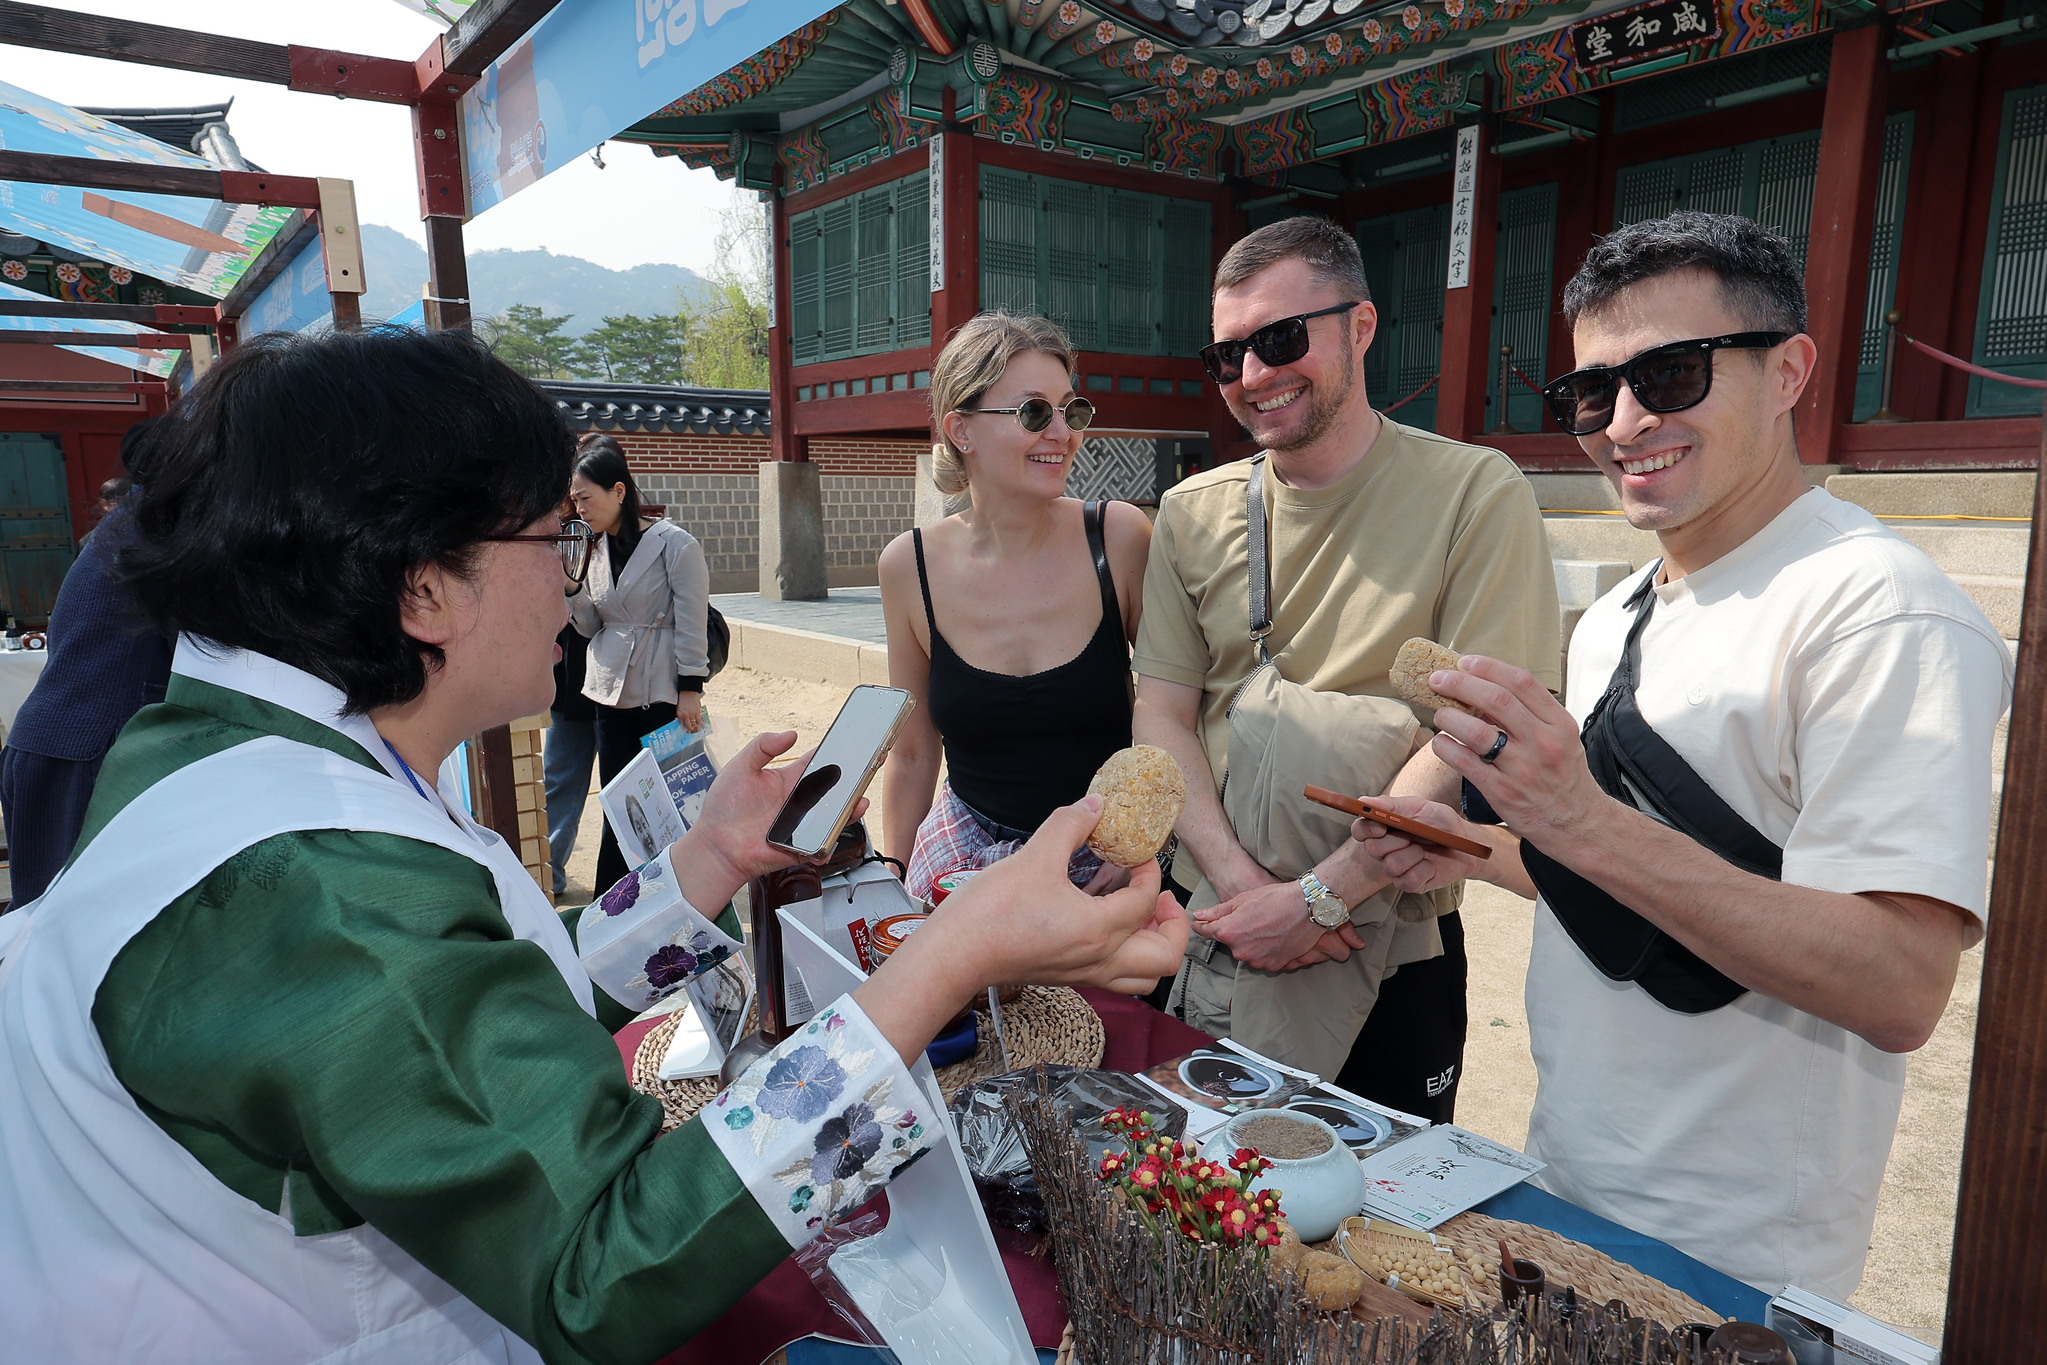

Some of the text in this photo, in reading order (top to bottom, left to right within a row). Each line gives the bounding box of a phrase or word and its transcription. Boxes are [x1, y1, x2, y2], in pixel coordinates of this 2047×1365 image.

[666, 761, 699, 784] APPING
[680, 765, 711, 785] PAPER
[671, 787, 687, 799] OK
[1426, 1064, 1455, 1093] EA7
